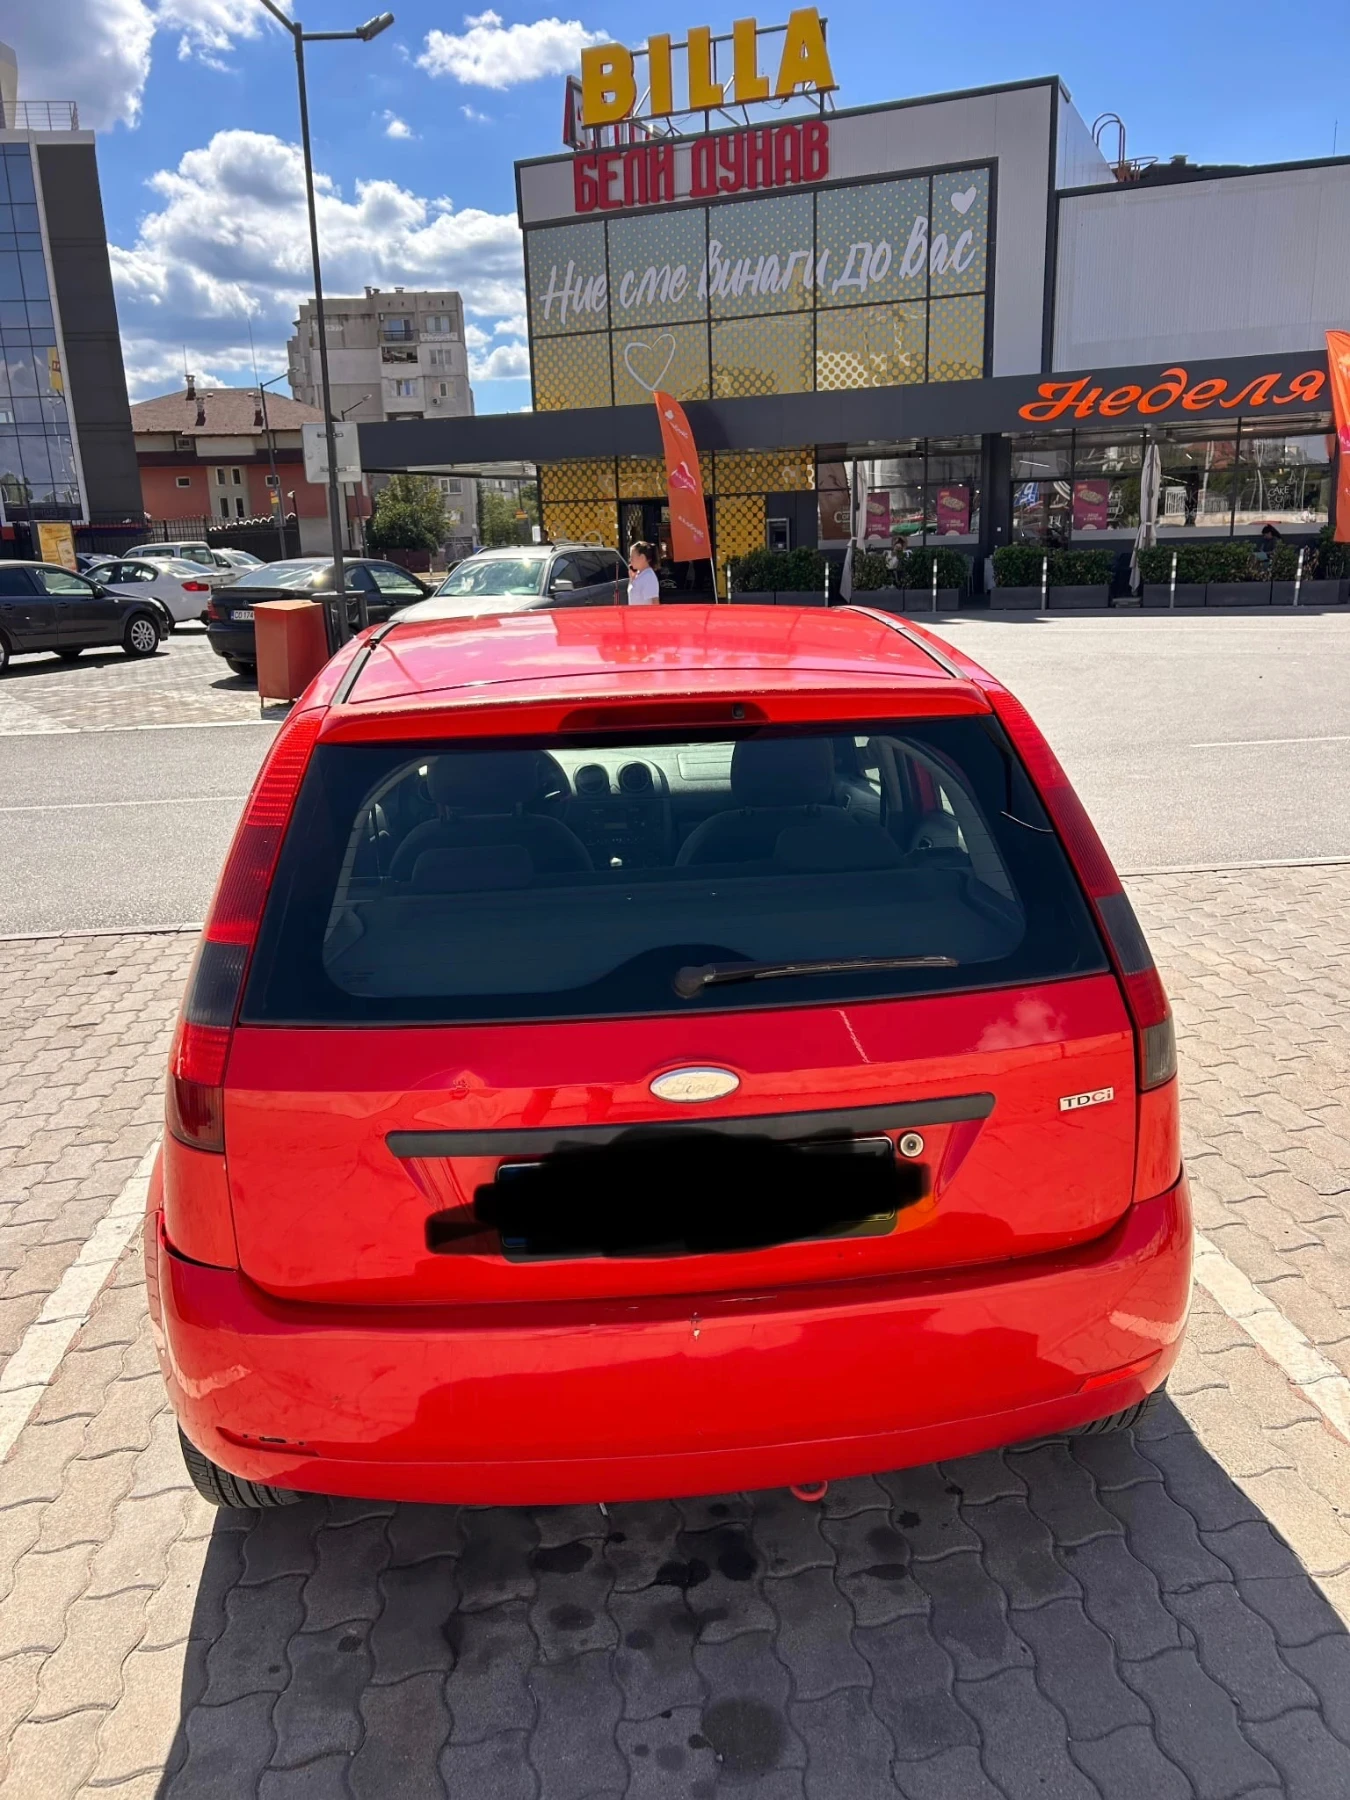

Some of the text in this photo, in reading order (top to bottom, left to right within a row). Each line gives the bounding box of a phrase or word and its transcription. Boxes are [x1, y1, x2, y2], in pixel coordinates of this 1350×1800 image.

[581, 7, 837, 127] BILLA
[574, 120, 830, 213] БЕЛИ ДУНАВ
[539, 259, 608, 325] Ние
[619, 263, 690, 309] сме
[832, 241, 892, 295] до
[1018, 367, 1327, 422] Неделя
[1062, 1089, 1112, 1108] TDCi
